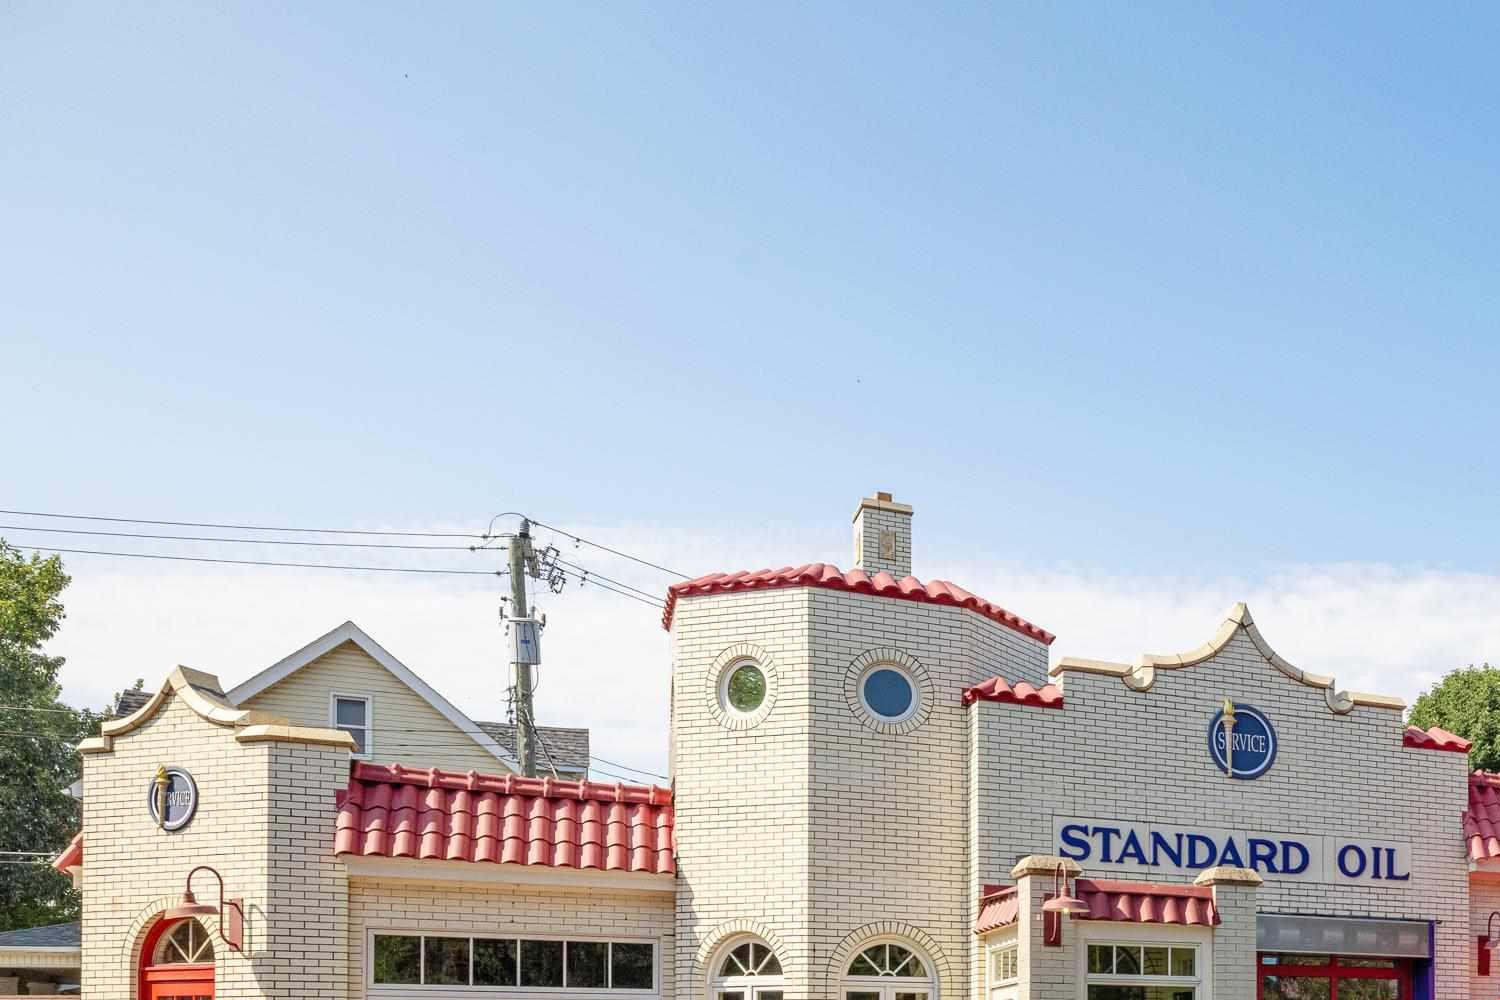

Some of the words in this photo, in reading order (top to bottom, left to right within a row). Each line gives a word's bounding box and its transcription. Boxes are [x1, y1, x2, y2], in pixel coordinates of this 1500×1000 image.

[1218, 731, 1266, 753] SRVICE
[158, 789, 191, 807] RVICE
[1060, 824, 1310, 875] STANDARD
[1338, 844, 1411, 881] OIL
